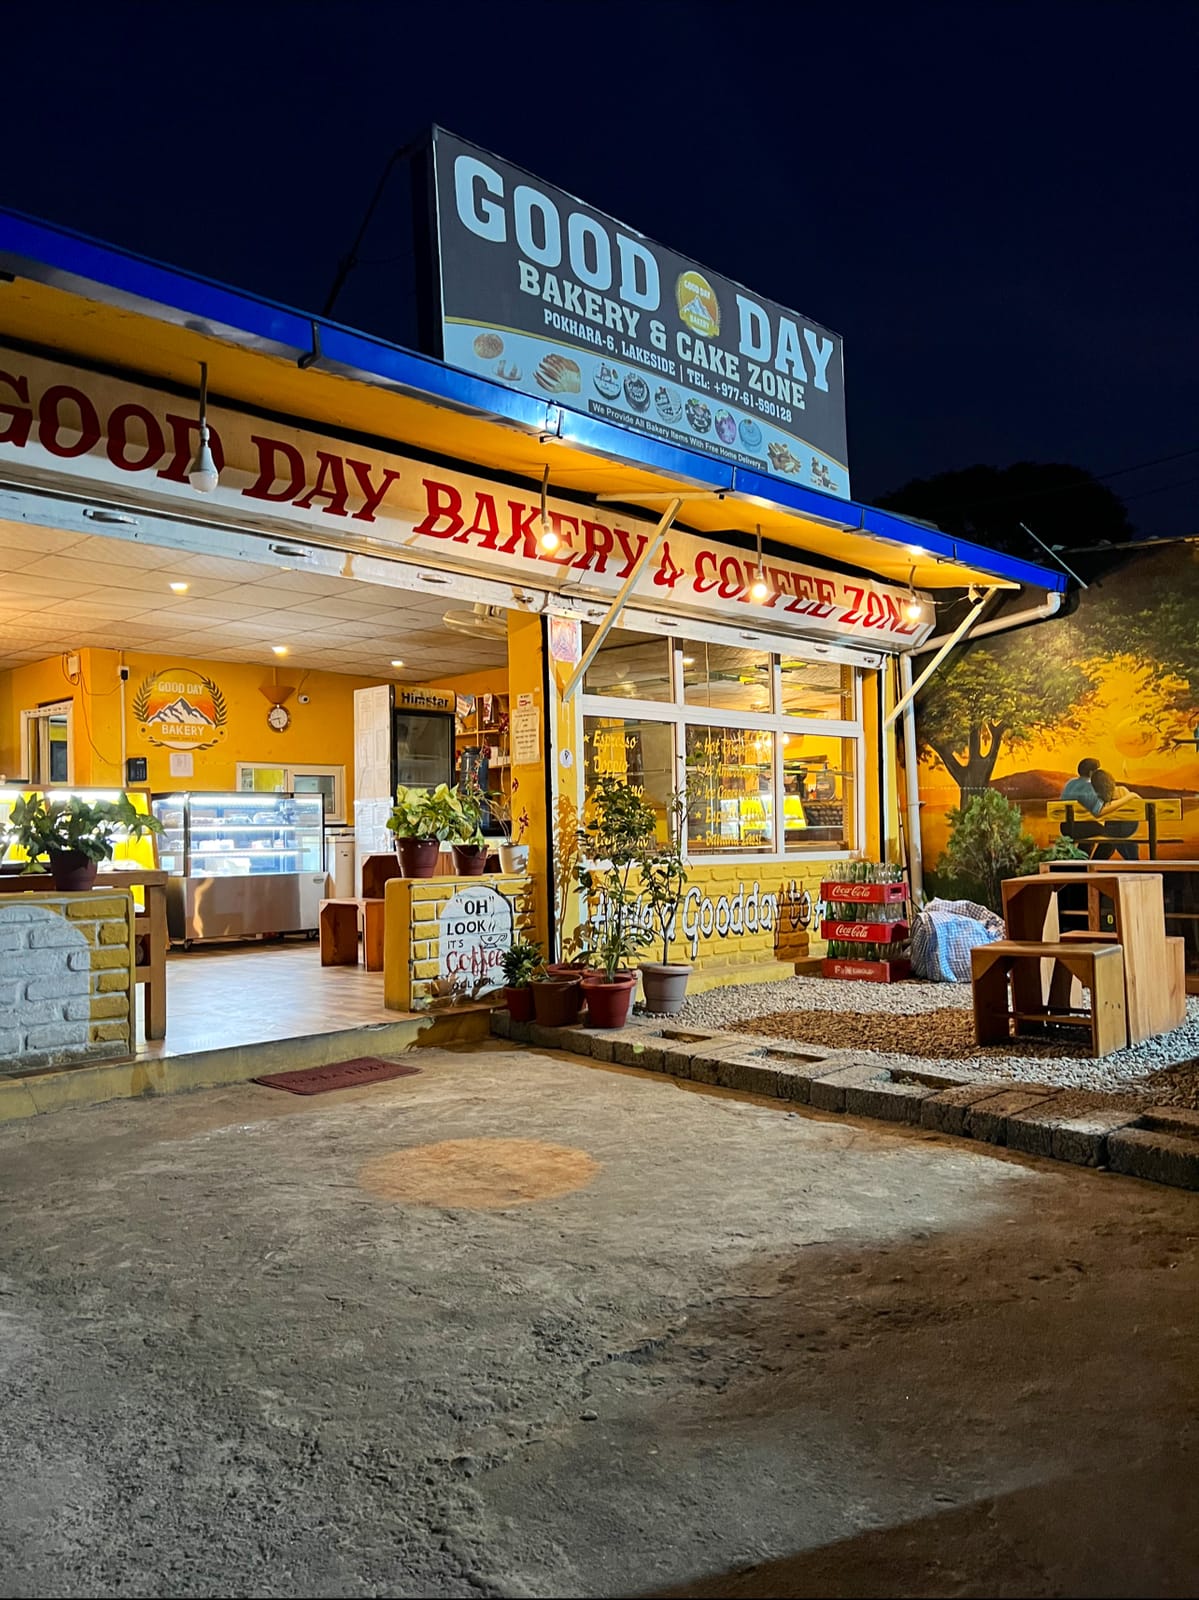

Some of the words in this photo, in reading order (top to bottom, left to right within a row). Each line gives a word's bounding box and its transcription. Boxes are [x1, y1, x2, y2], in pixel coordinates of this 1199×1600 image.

[454, 155, 661, 312] GOOD
[736, 294, 834, 393] DAY
[518, 260, 640, 339] BAKERY
[650, 315, 667, 351] &
[677, 331, 740, 382] CAKE
[747, 363, 806, 410] ZONE
[544, 308, 618, 354] POKHARA-6,
[622, 341, 676, 377] LAKESIDE
[687, 367, 710, 390] TEL:
[714, 381, 792, 423] +977-61-590128
[592, 402, 605, 414] We
[606, 406, 634, 425] Provide
[635, 416, 645, 428] All
[646, 419, 669, 438] Bakery
[670, 429, 689, 444] Items
[689, 436, 704, 449] With
[705, 441, 719, 454] Free
[719, 446, 737, 460] Home
[241, 434, 400, 522] DAY
[413, 478, 649, 578] BAKERY
[653, 541, 685, 588] &
[693, 551, 837, 619] COFFEE
[838, 585, 921, 636] ZONE
[158, 681, 185, 694] GOOD
[186, 683, 204, 695] DAY
[401, 692, 449, 708] Himstar
[161, 724, 205, 737] BAKERY
[593, 730, 638, 753] Espresso
[593, 755, 630, 778] Doppio
[788, 879, 812, 929] to
[447, 920, 486, 936] LOOK
[446, 944, 504, 976] Coffee
